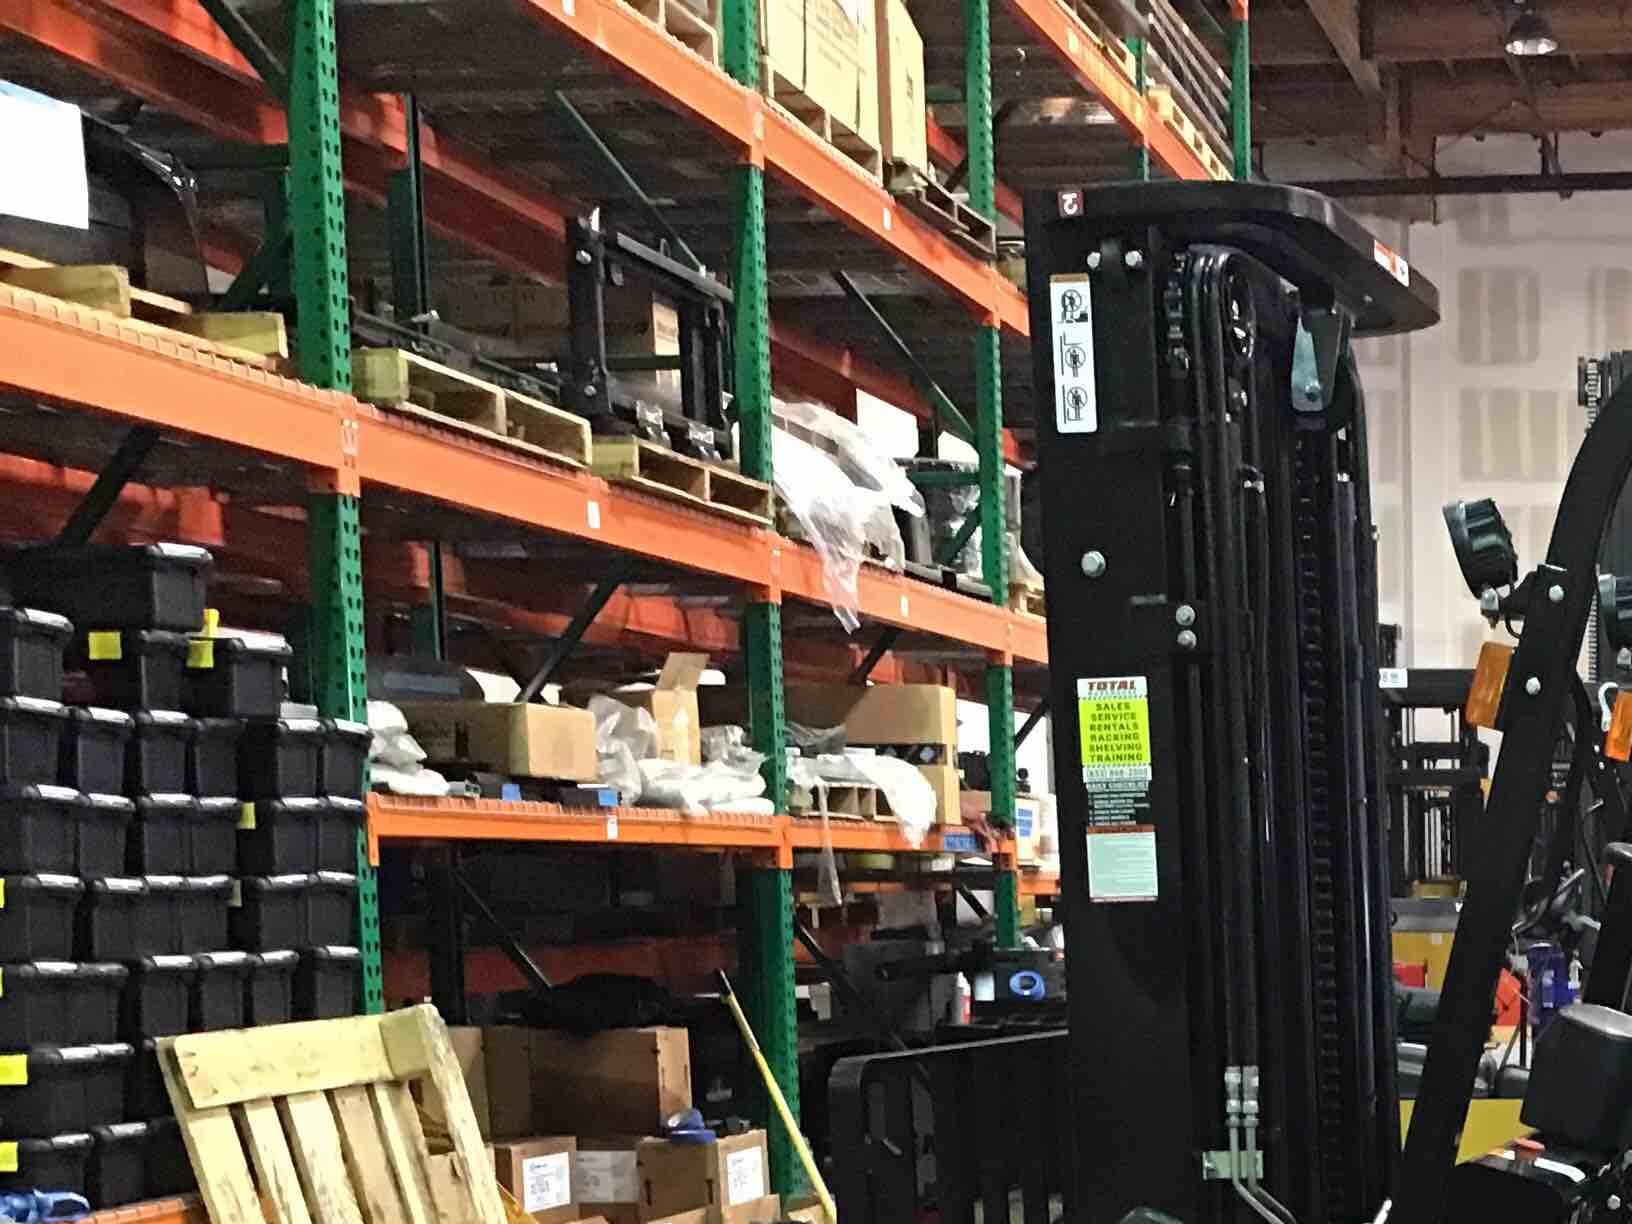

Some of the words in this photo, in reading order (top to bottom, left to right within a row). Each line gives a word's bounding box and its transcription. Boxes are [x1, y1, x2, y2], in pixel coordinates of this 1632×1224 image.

[1088, 680, 1136, 690] TOTAL
[1096, 702, 1131, 711] SALES
[1090, 712, 1136, 721] SERVICE
[1089, 722, 1139, 731] RENTALS
[1090, 732, 1139, 742] RACKING
[1089, 743, 1142, 752] SHELVING
[1089, 753, 1143, 763] TRAINING
